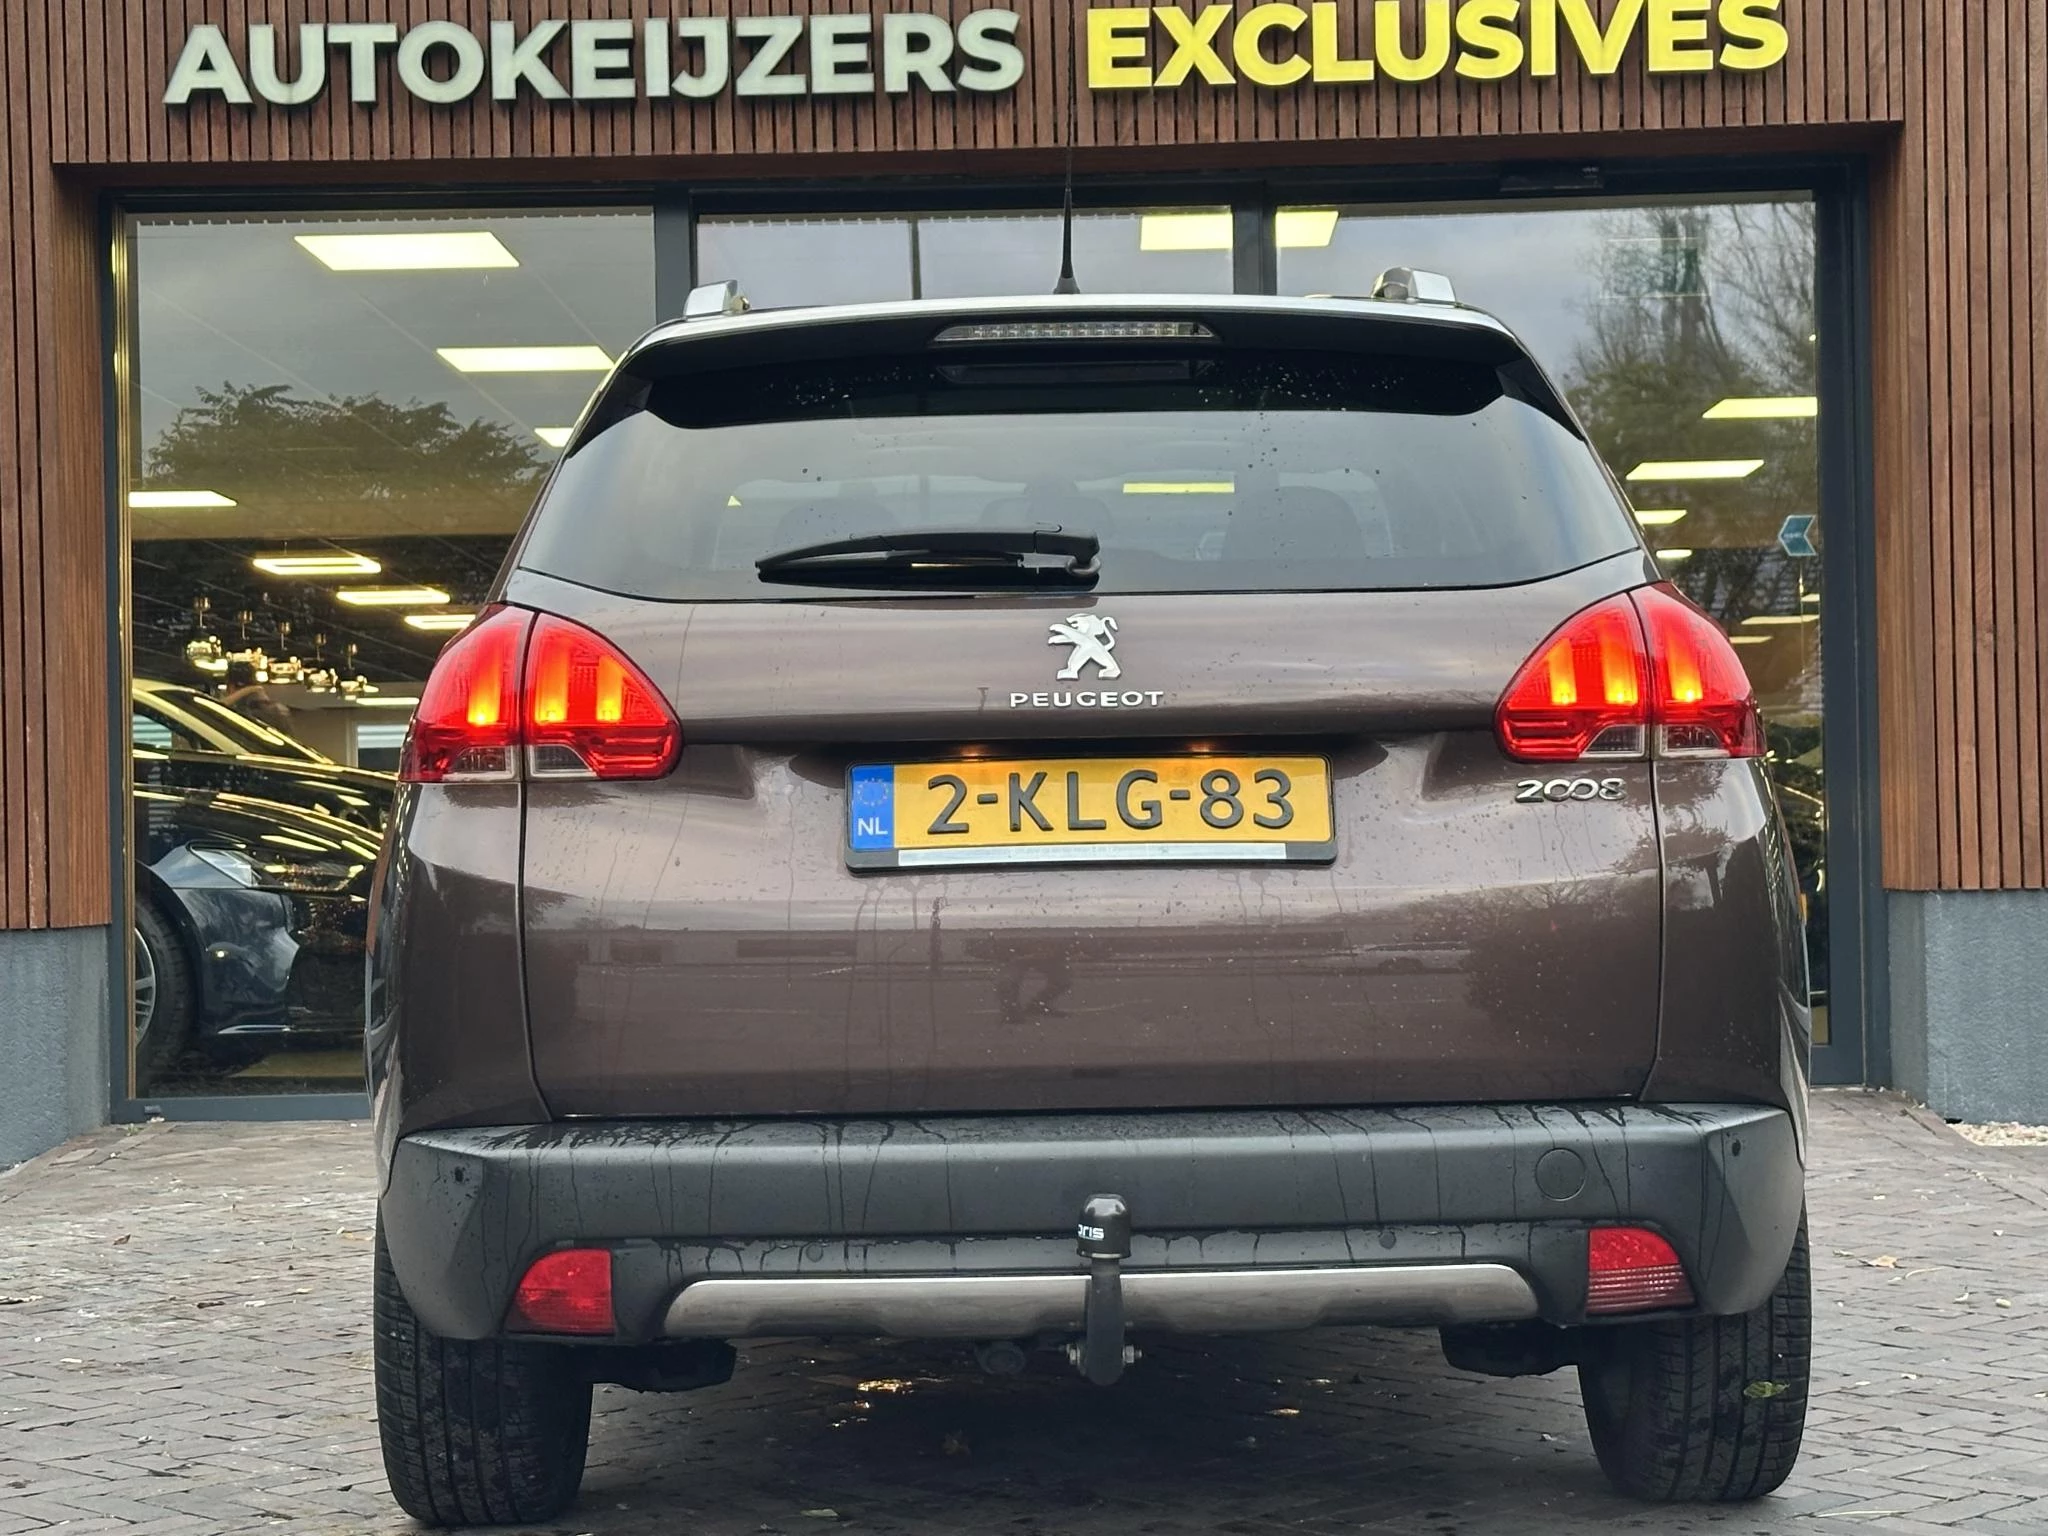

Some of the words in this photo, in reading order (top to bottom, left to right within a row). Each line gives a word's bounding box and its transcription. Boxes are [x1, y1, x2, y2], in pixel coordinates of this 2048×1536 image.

[163, 8, 1026, 107] AUTOKEIJZERS
[1086, 0, 1791, 90] EXCLUSIVES
[1009, 690, 1165, 708] PEUGEOT
[926, 768, 1295, 836] 2-KLG-83
[1515, 777, 1627, 803] 2008
[857, 817, 889, 837] NL
